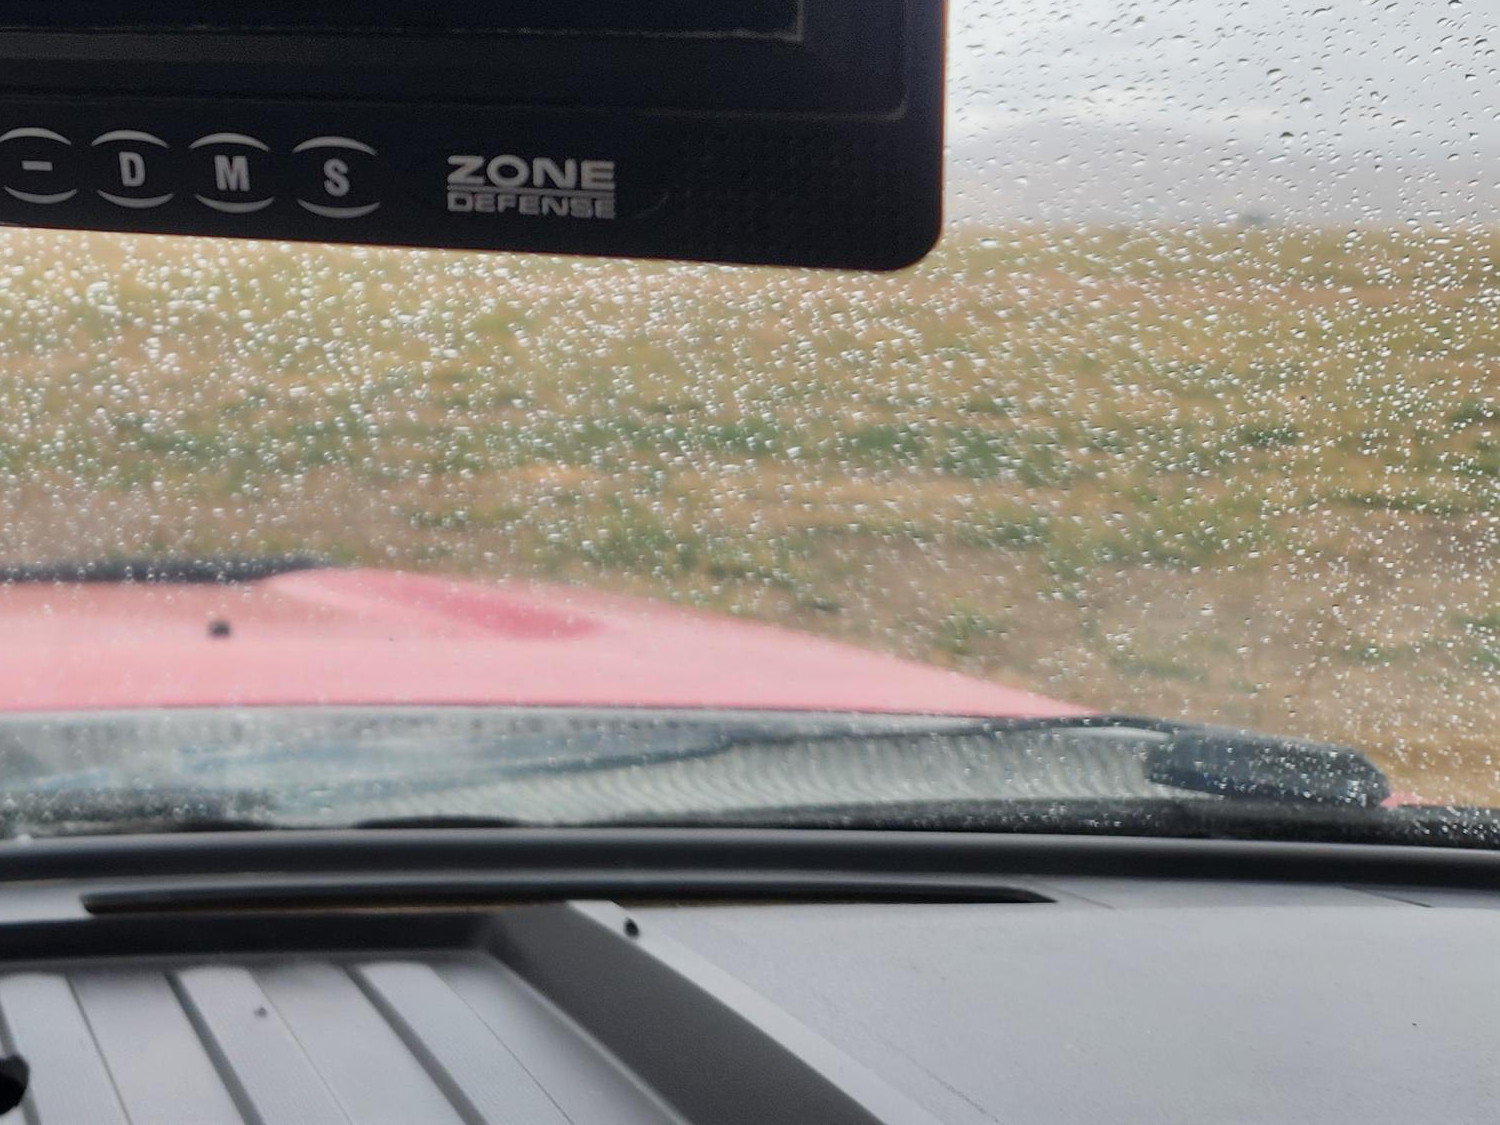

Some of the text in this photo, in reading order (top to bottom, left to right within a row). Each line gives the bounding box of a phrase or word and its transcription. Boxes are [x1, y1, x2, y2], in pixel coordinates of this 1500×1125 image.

[118, 150, 147, 188] D
[213, 154, 250, 193] M
[322, 157, 351, 198] S
[446, 154, 616, 191] ZONE
[446, 191, 616, 220] DEFENSE
